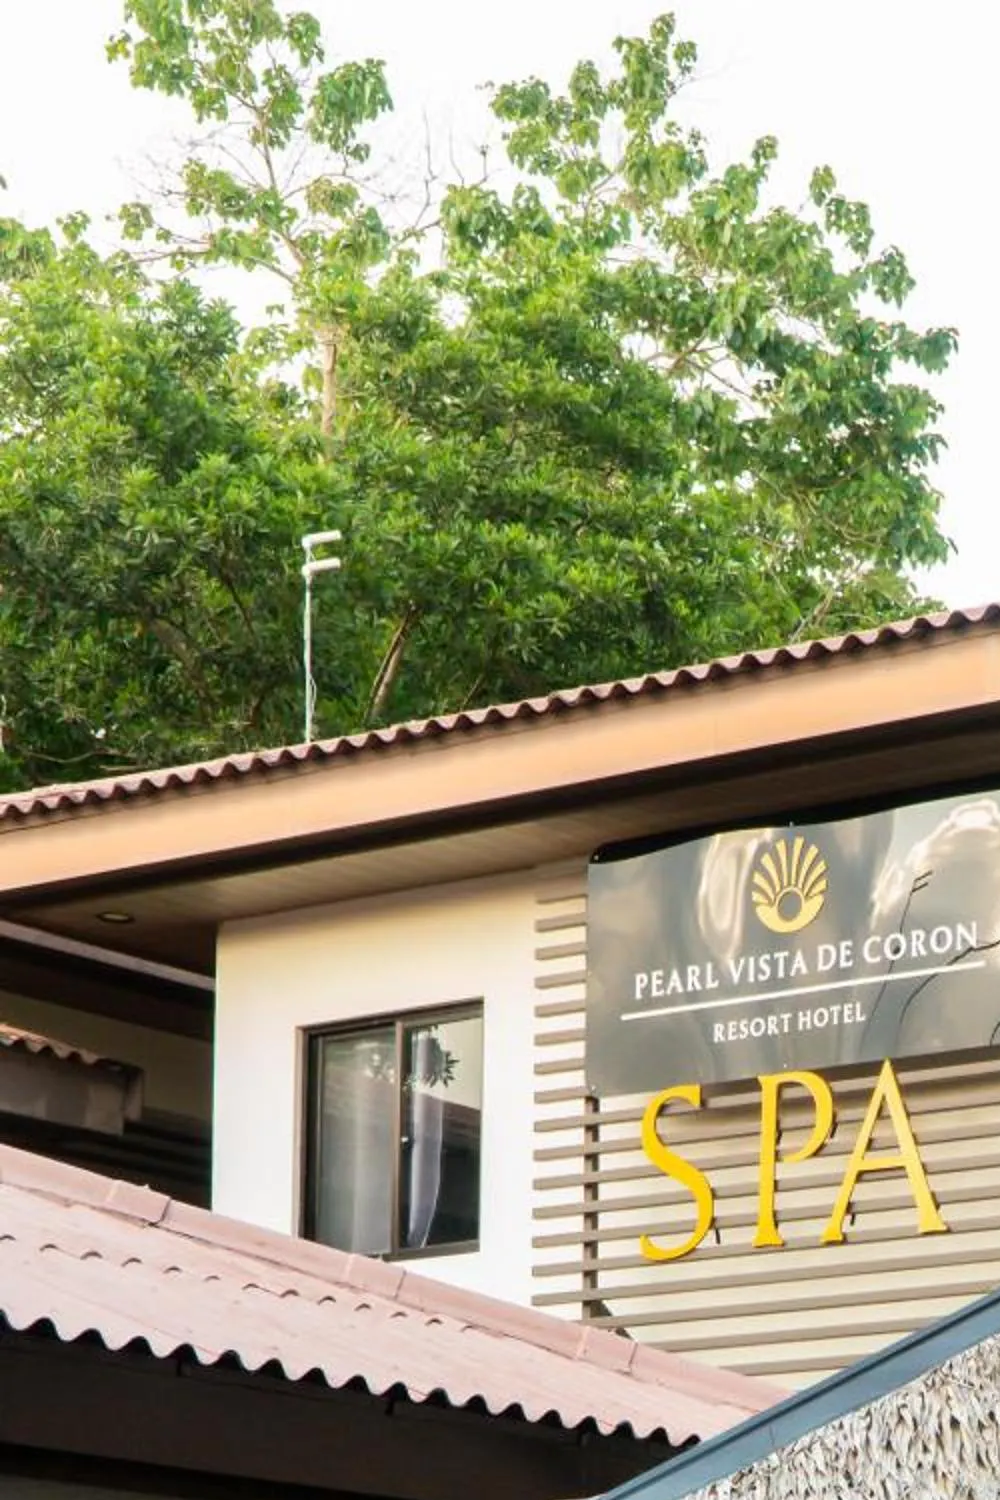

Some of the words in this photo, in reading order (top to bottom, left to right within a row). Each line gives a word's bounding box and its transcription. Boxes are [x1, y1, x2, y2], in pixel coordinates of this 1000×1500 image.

[634, 961, 720, 1001] PEARL
[729, 948, 809, 986] VISTA
[816, 939, 854, 973] DE
[862, 920, 979, 963] CORON
[713, 1012, 792, 1043] RESORT
[797, 1001, 867, 1032] HOTEL
[639, 1056, 949, 1262] SPA
